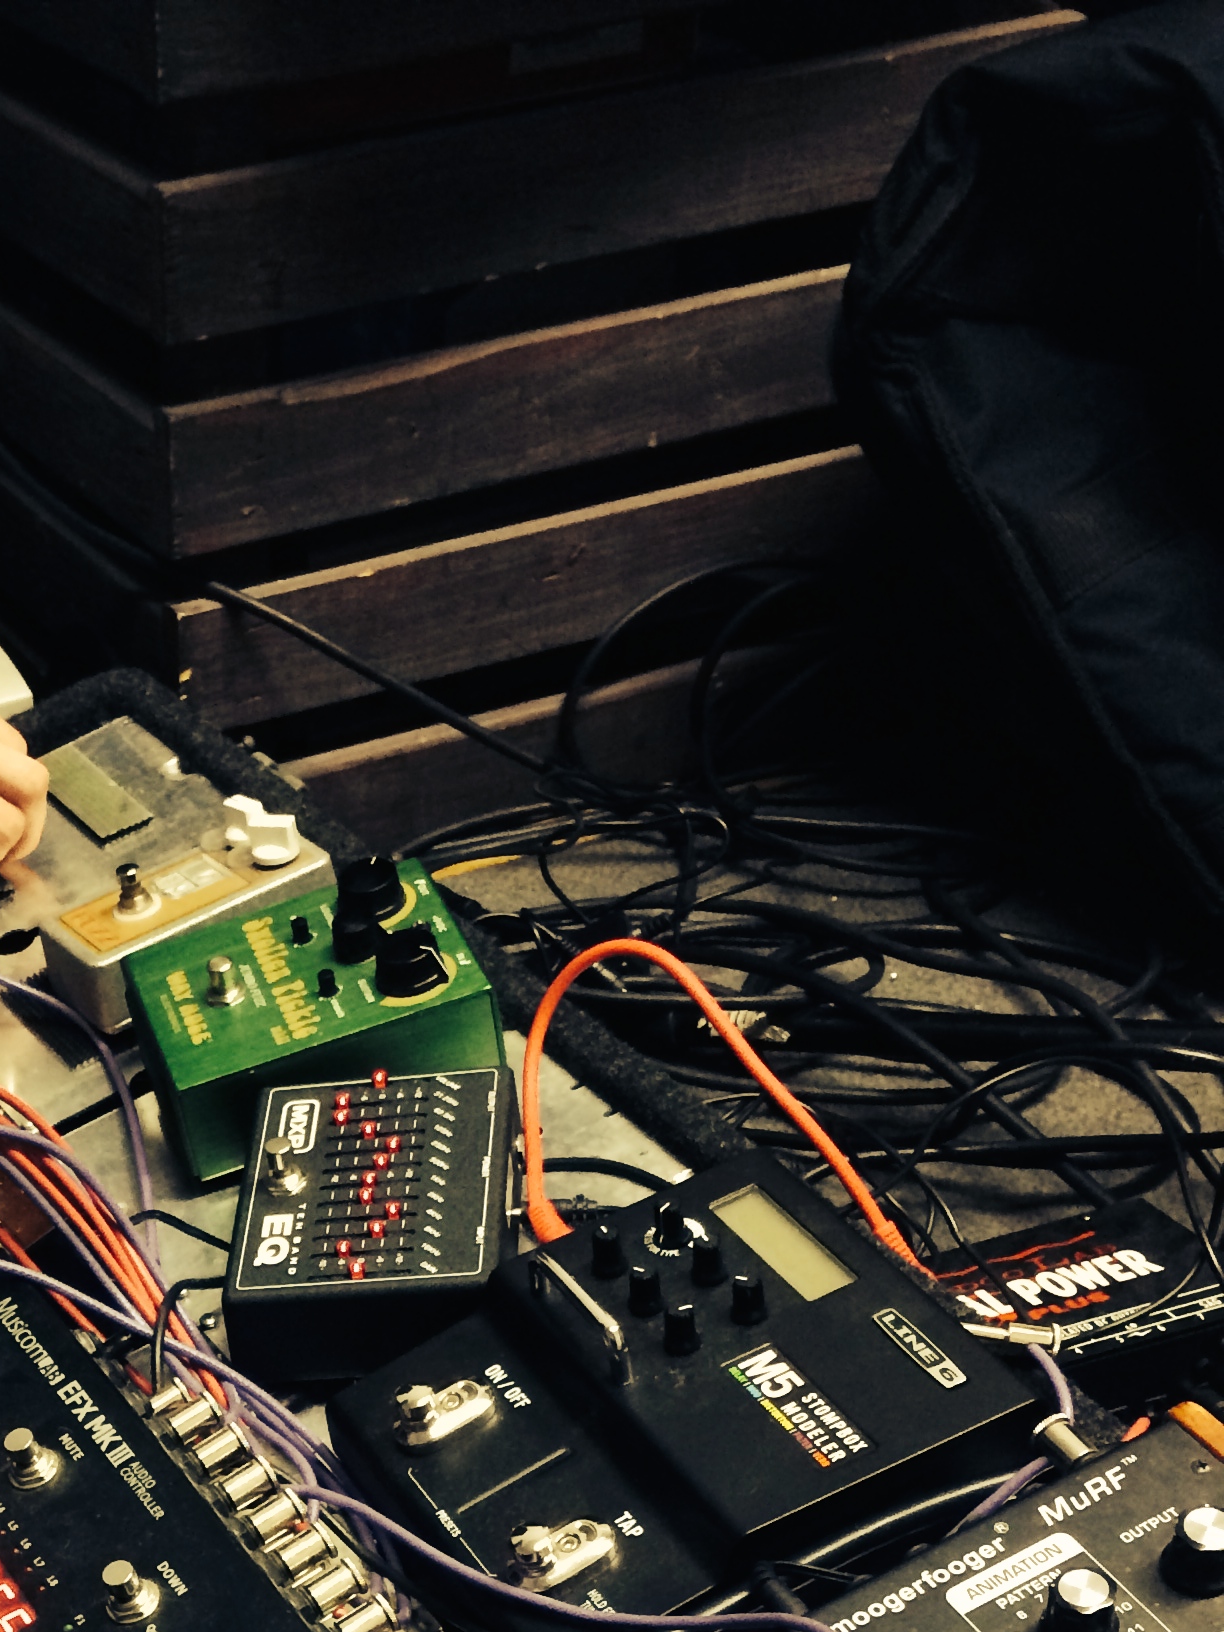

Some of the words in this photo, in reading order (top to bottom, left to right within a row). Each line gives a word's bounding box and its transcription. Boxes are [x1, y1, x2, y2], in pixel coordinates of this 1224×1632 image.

[241, 916, 292, 984] Swollen
[271, 978, 321, 1040] Pickle
[294, 1202, 307, 1231] TEN
[253, 1213, 294, 1267] EQ
[287, 1236, 302, 1276] BAND
[1006, 1249, 1165, 1306] POWER
[881, 1313, 940, 1365] LINE
[938, 1367, 959, 1382] 6
[737, 1349, 805, 1399] M5
[56, 1379, 100, 1423] EFX
[780, 1401, 847, 1463] MODELER
[801, 1392, 869, 1454] STOMPBOX
[58, 1432, 86, 1462] MUTE
[119, 1466, 166, 1521] CONTROLLER
[128, 1460, 158, 1490] AUDIO
[1037, 1465, 1129, 1527] MuRF
[7, 1519, 20, 1532] L5
[20, 1537, 33, 1550] L6
[435, 1509, 462, 1539] PRESETS
[614, 1510, 645, 1538] TAP
[1119, 1506, 1181, 1545] OUTPUT
[156, 1560, 190, 1597] DOWN
[966, 1542, 1064, 1602] ANIMATION
[994, 1567, 1063, 1611] PATTERN
[586, 1588, 608, 1609] HOLD
[1015, 1609, 1029, 1622] 6
[1034, 1592, 1046, 1605] 7
[1114, 1600, 1134, 1616] 10
[73, 1613, 87, 1627] F1
